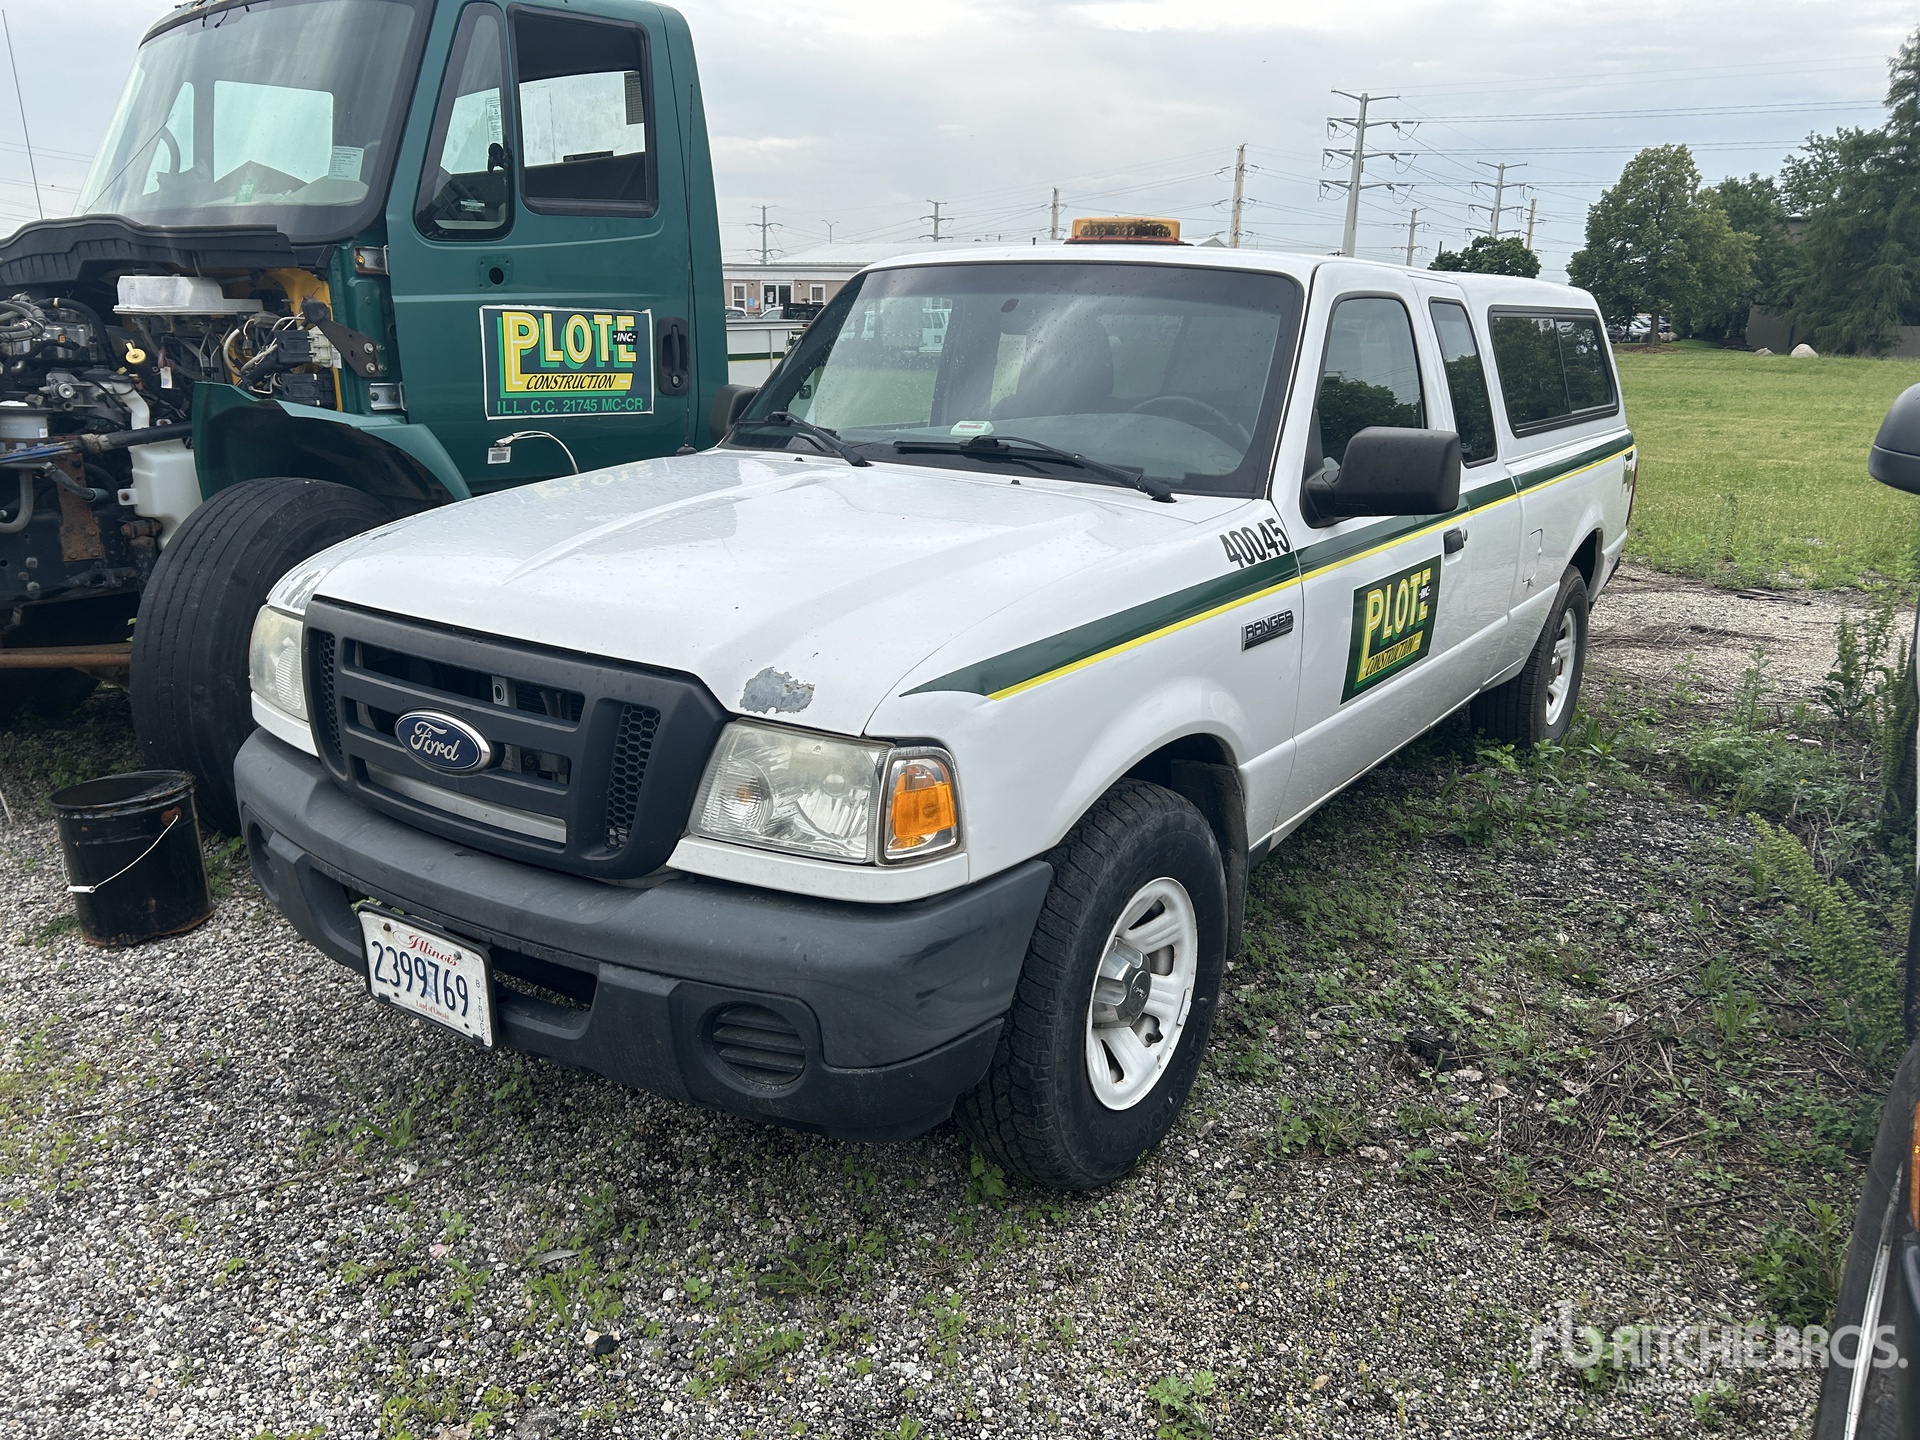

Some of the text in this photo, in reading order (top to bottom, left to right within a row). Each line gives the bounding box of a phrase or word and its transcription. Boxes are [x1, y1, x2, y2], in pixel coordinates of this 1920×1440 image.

[501, 311, 637, 376] PLOTE
[526, 374, 616, 390] CONSTRUCTION
[497, 397, 643, 414] ILL. C.C. 21745 MC-CR
[1245, 610, 1293, 639] RANGER
[1363, 567, 1432, 645] PLOTE
[1365, 636, 1416, 676] CONSTRUCTION
[410, 721, 460, 761] Ford
[393, 931, 459, 966] Illinois
[371, 940, 469, 1017] 2399769
